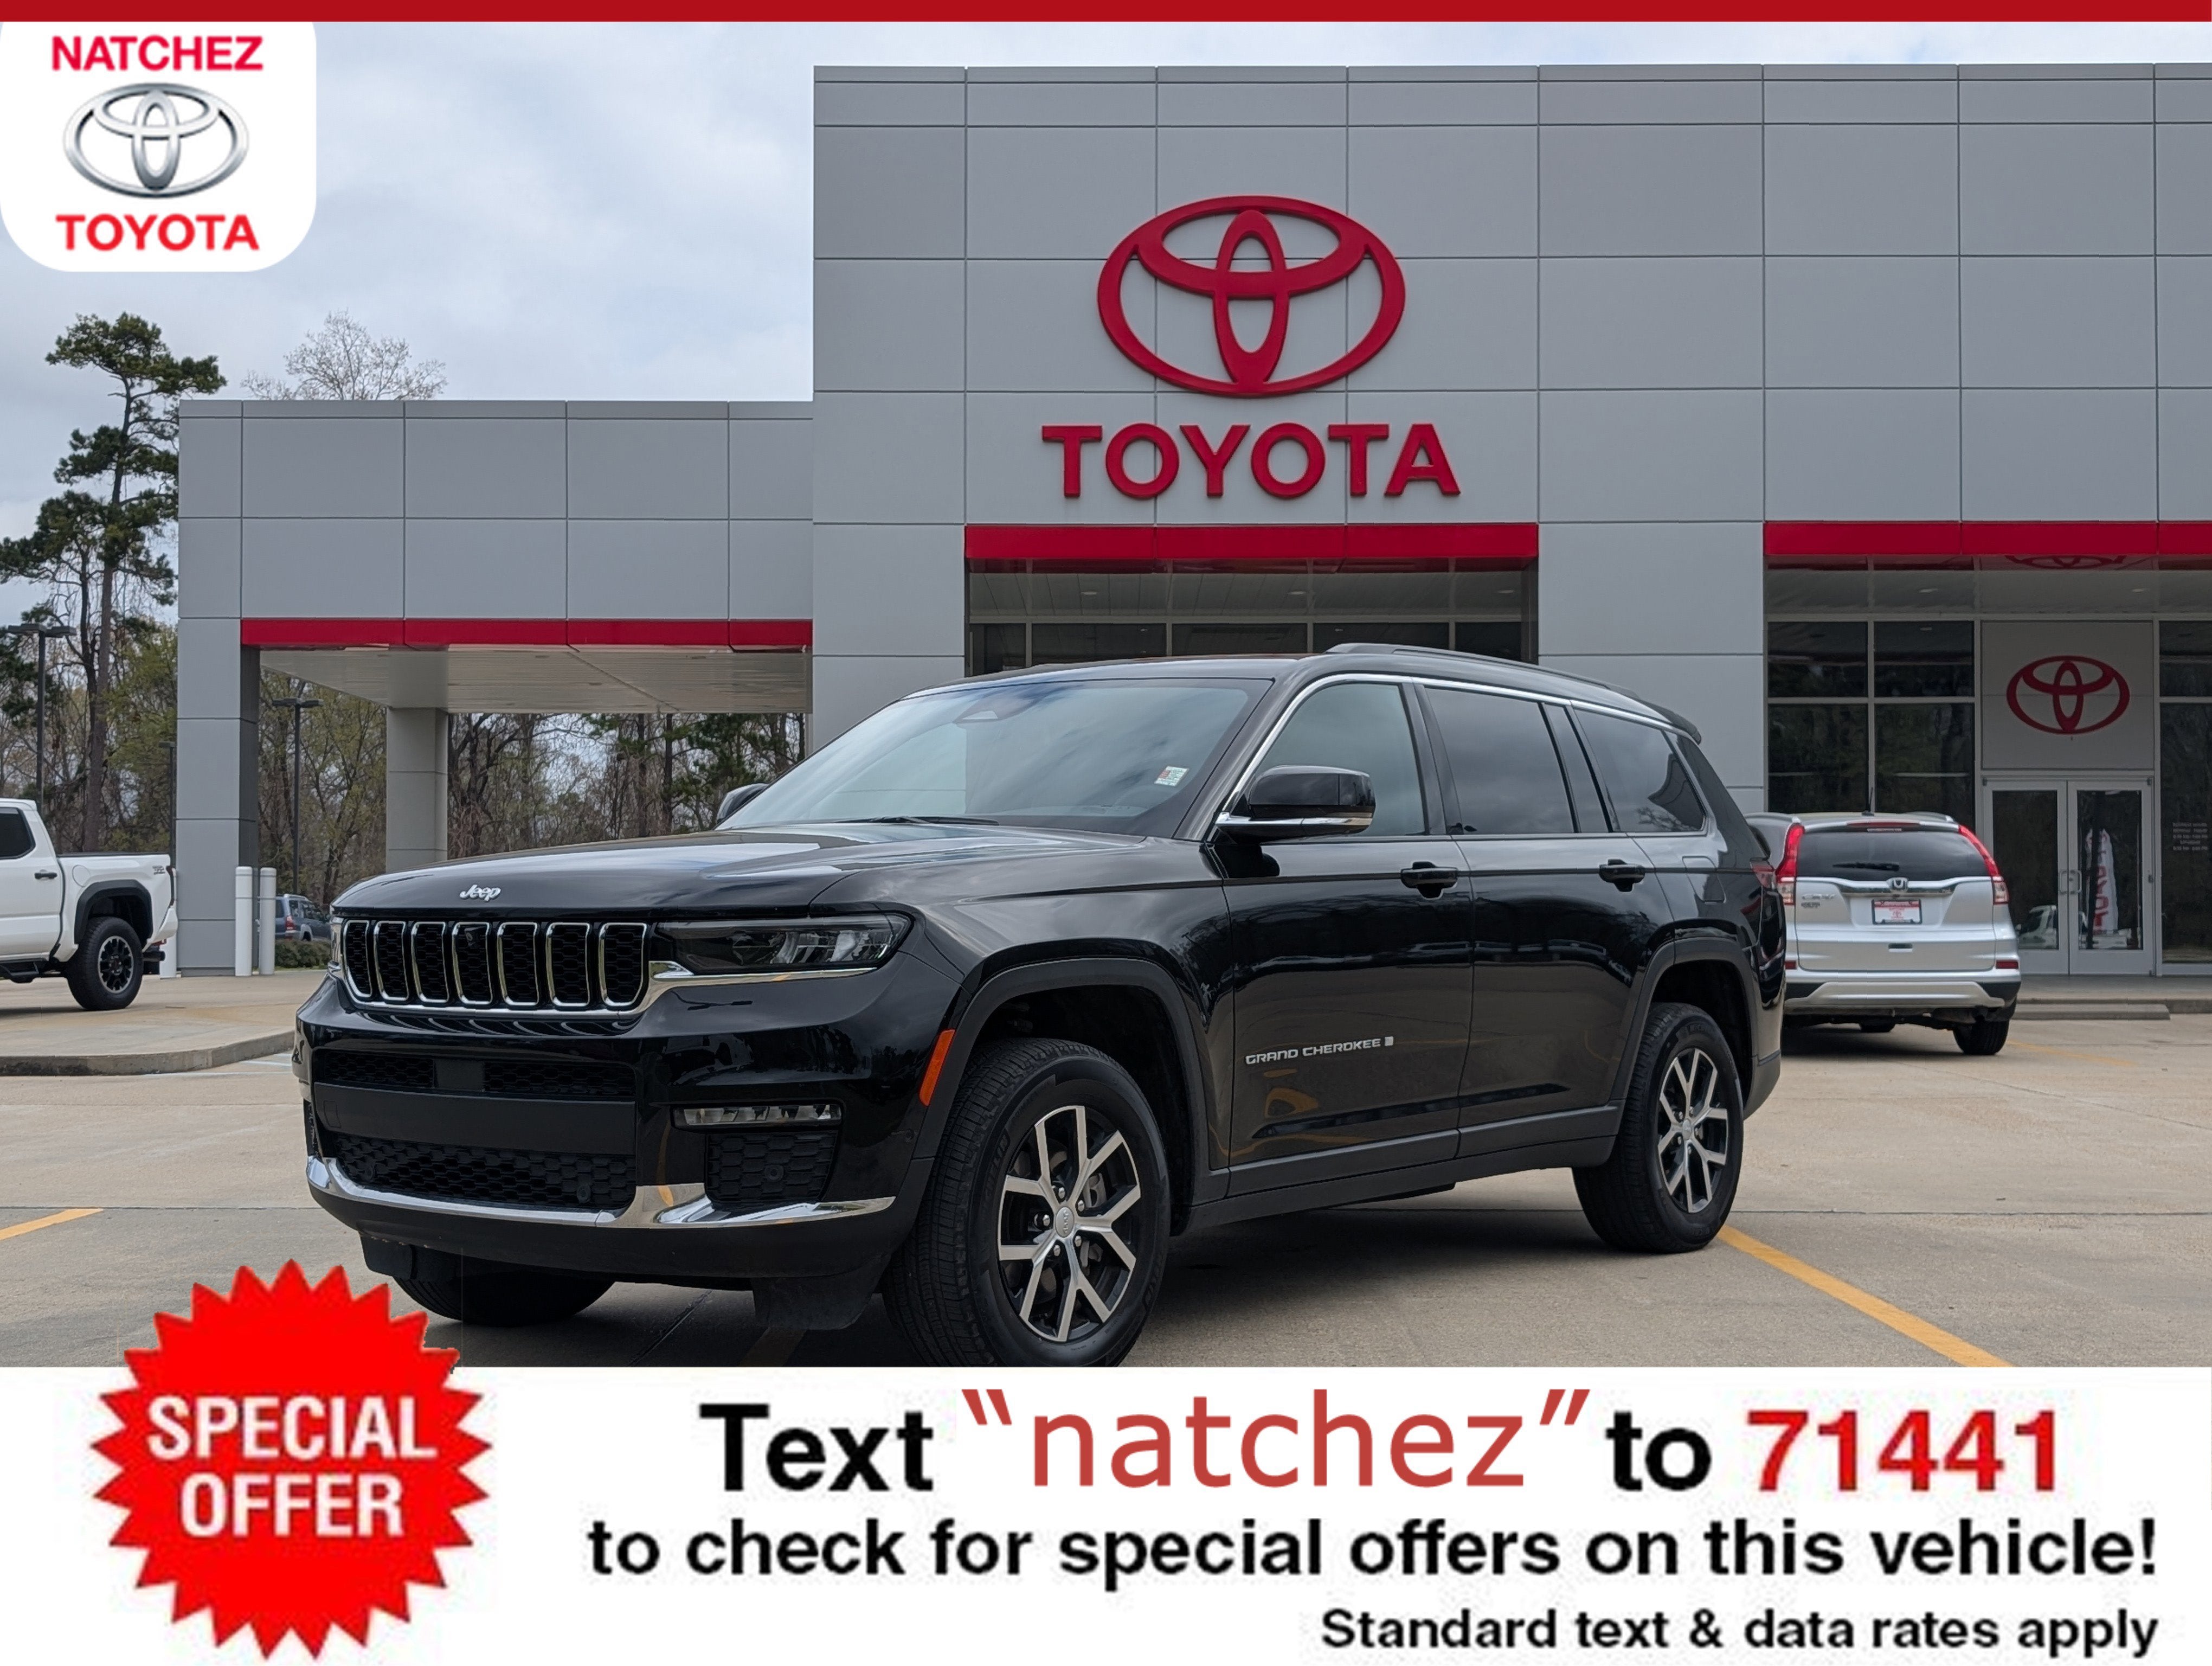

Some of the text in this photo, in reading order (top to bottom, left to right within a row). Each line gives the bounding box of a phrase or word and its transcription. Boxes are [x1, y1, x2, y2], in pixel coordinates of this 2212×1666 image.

[1041, 422, 1462, 499] TOYOTA
[459, 884, 501, 901] Jeep
[1245, 1039, 1381, 1065] GRAND CHEROKEE
